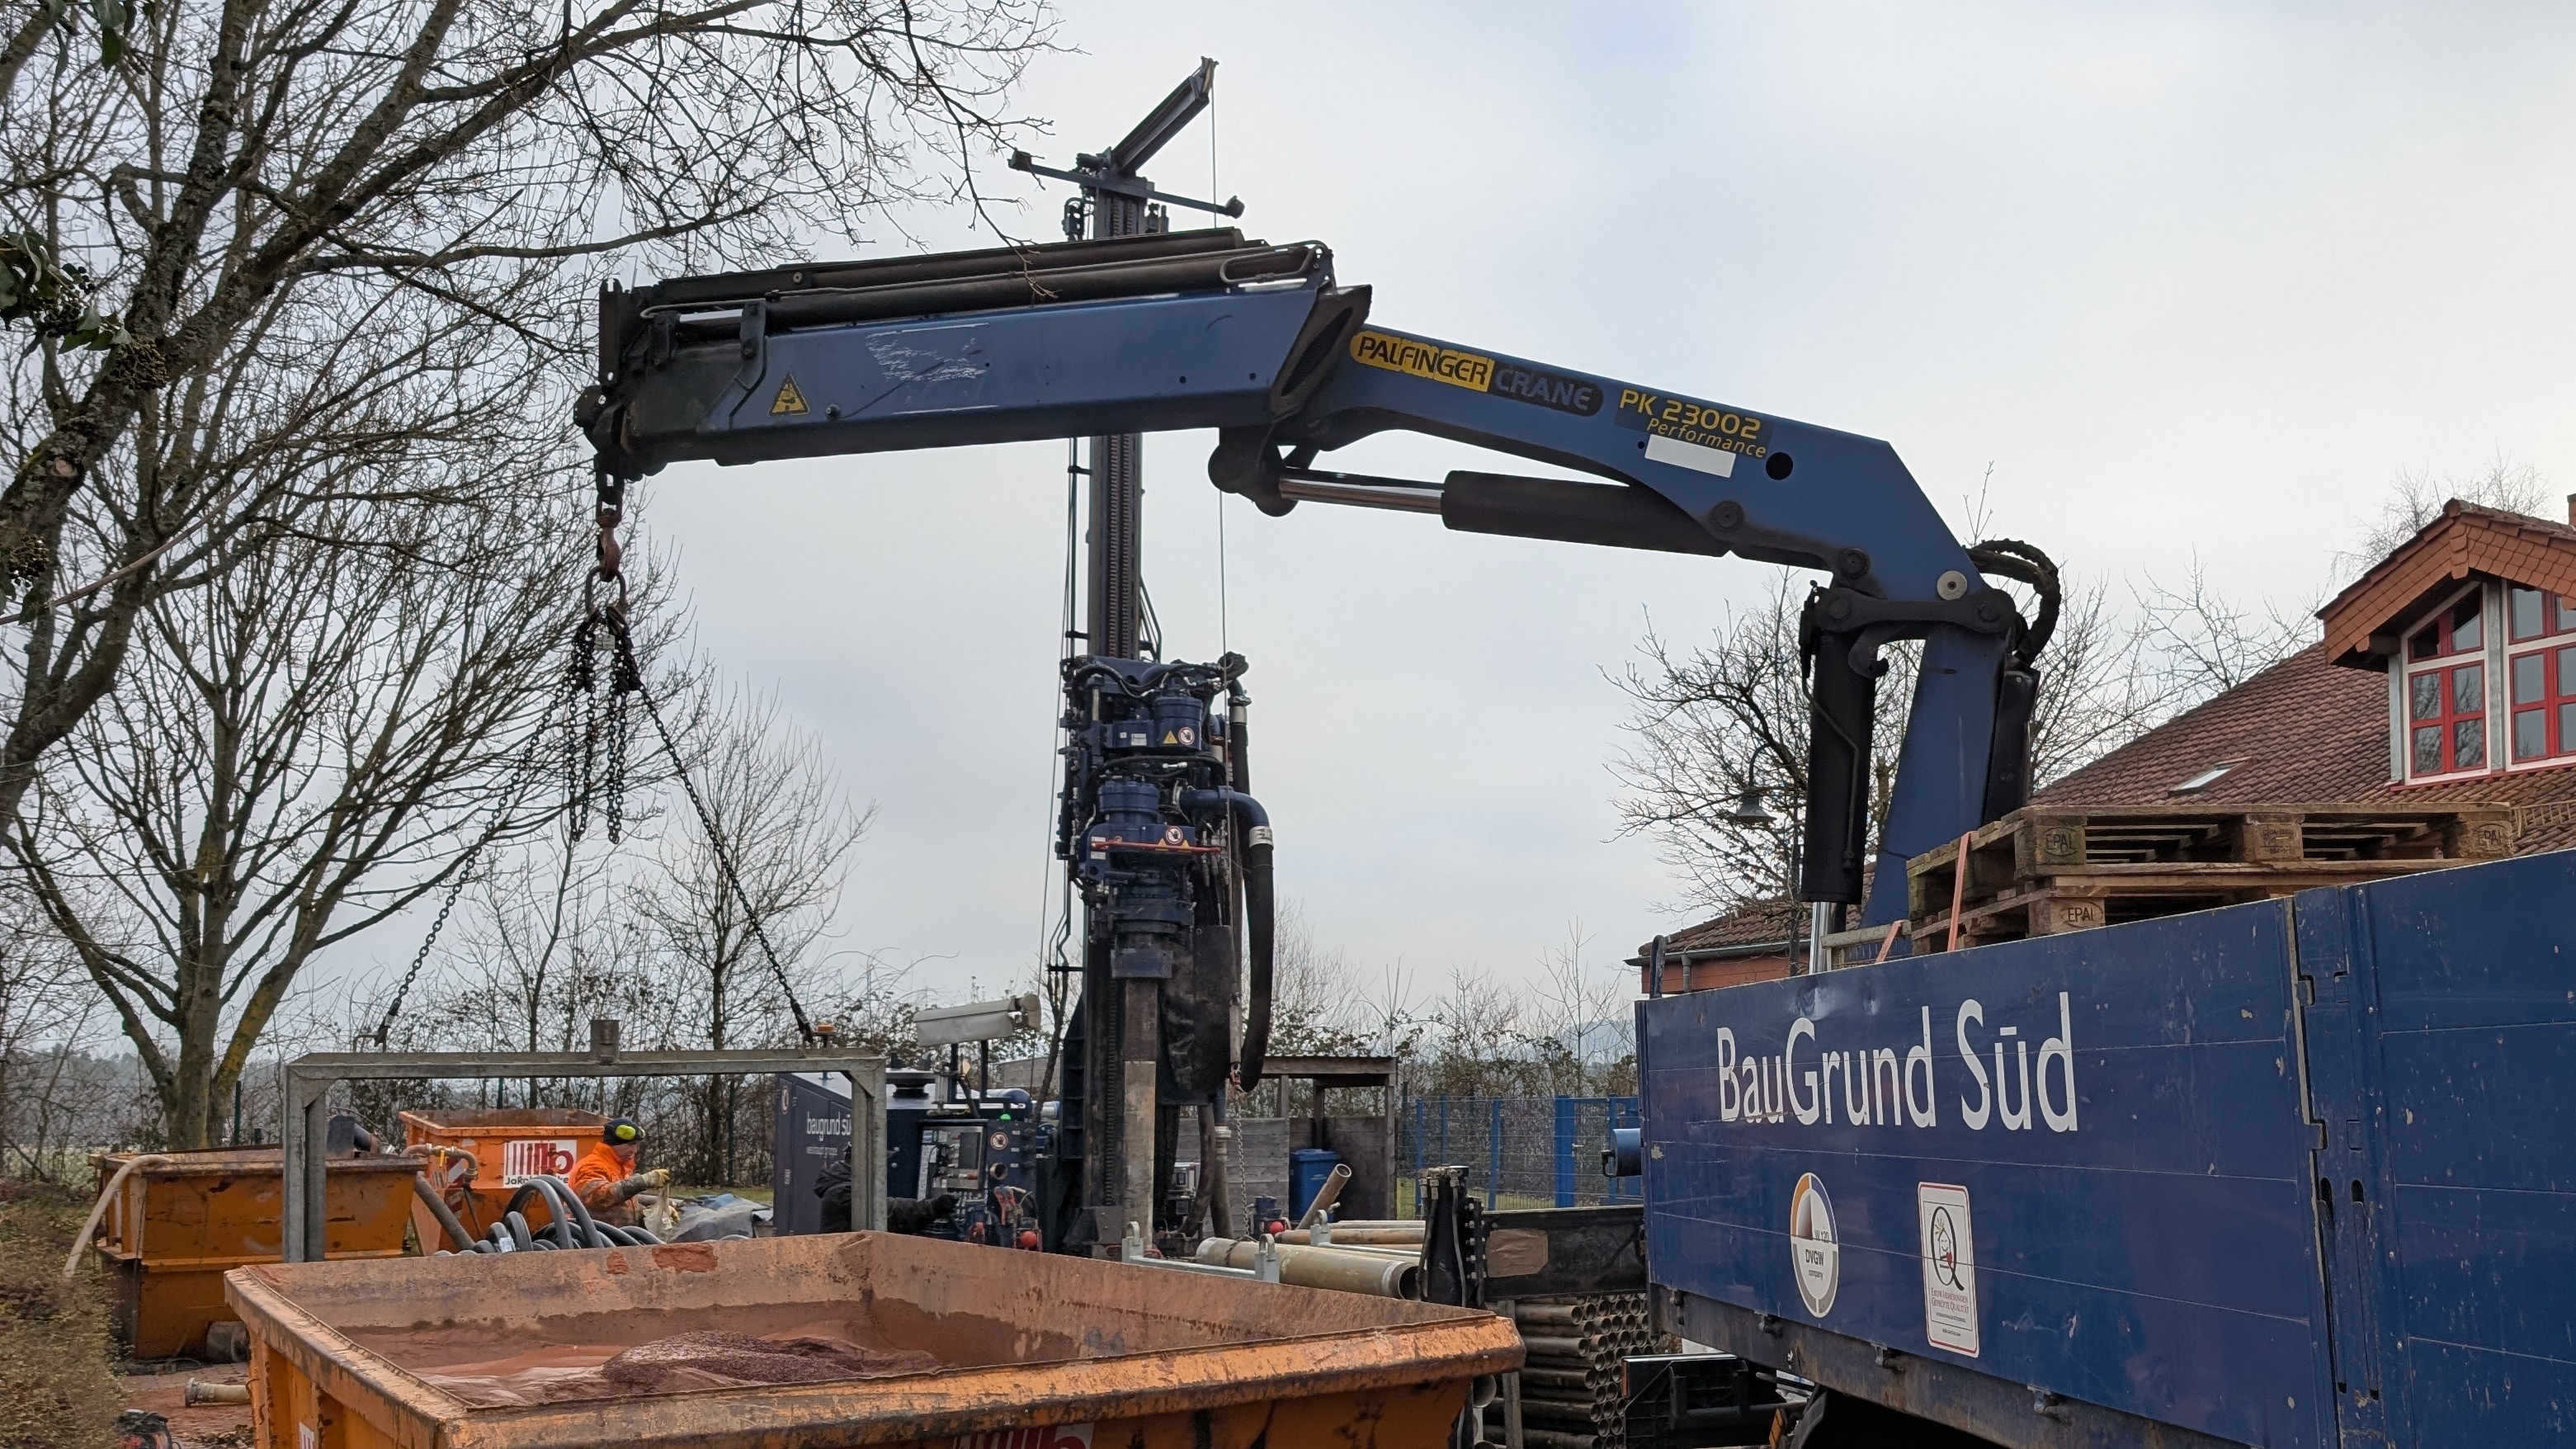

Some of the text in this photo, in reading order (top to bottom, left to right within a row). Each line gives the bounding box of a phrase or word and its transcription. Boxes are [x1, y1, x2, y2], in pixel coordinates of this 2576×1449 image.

[1357, 335, 1592, 410] PALFINGER CRANE
[1619, 389, 1761, 440] PK 23002
[1646, 418, 1767, 458] Performance
[2045, 833, 2077, 852] EPAL
[2067, 907, 2098, 923] EPAL
[1716, 1006, 1937, 1127] BauGrund
[807, 1112, 840, 1141] baugrund
[1805, 1248, 1824, 1266] DVGW
